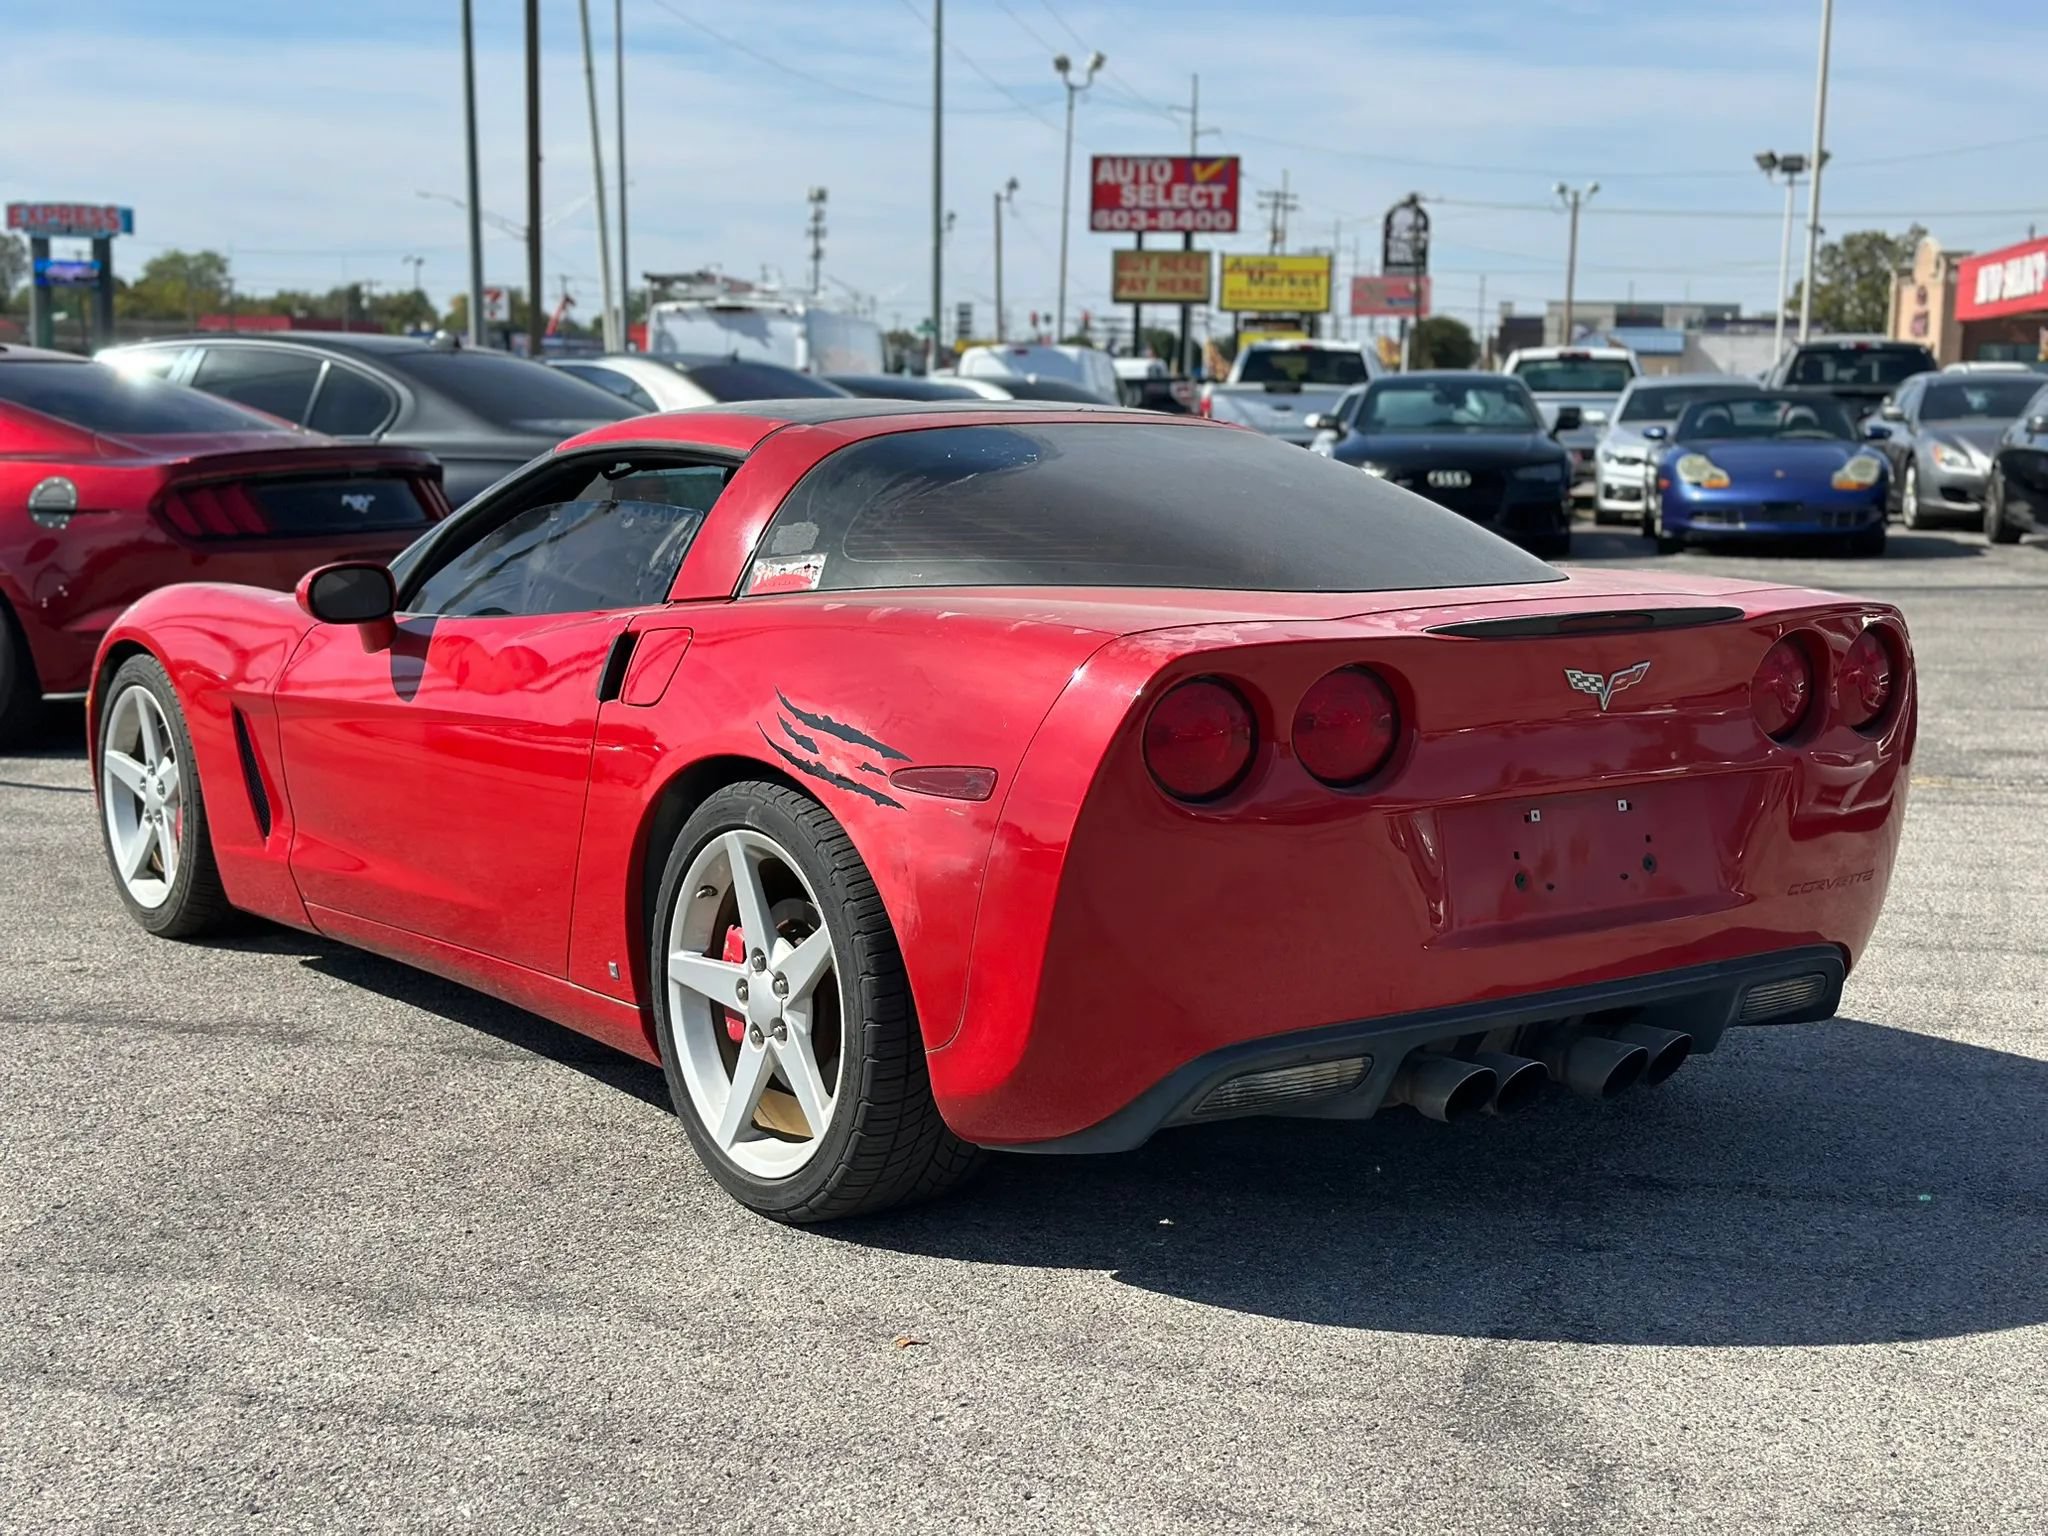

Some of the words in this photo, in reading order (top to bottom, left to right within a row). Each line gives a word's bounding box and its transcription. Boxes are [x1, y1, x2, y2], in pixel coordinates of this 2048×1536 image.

[1097, 159, 1172, 184] AUTO
[1120, 184, 1228, 208] SELECT
[7, 203, 120, 232] EXPRESS
[1157, 277, 1204, 294] HERE
[1247, 270, 1321, 287] Market
[1787, 868, 1875, 897] CORVETTE
